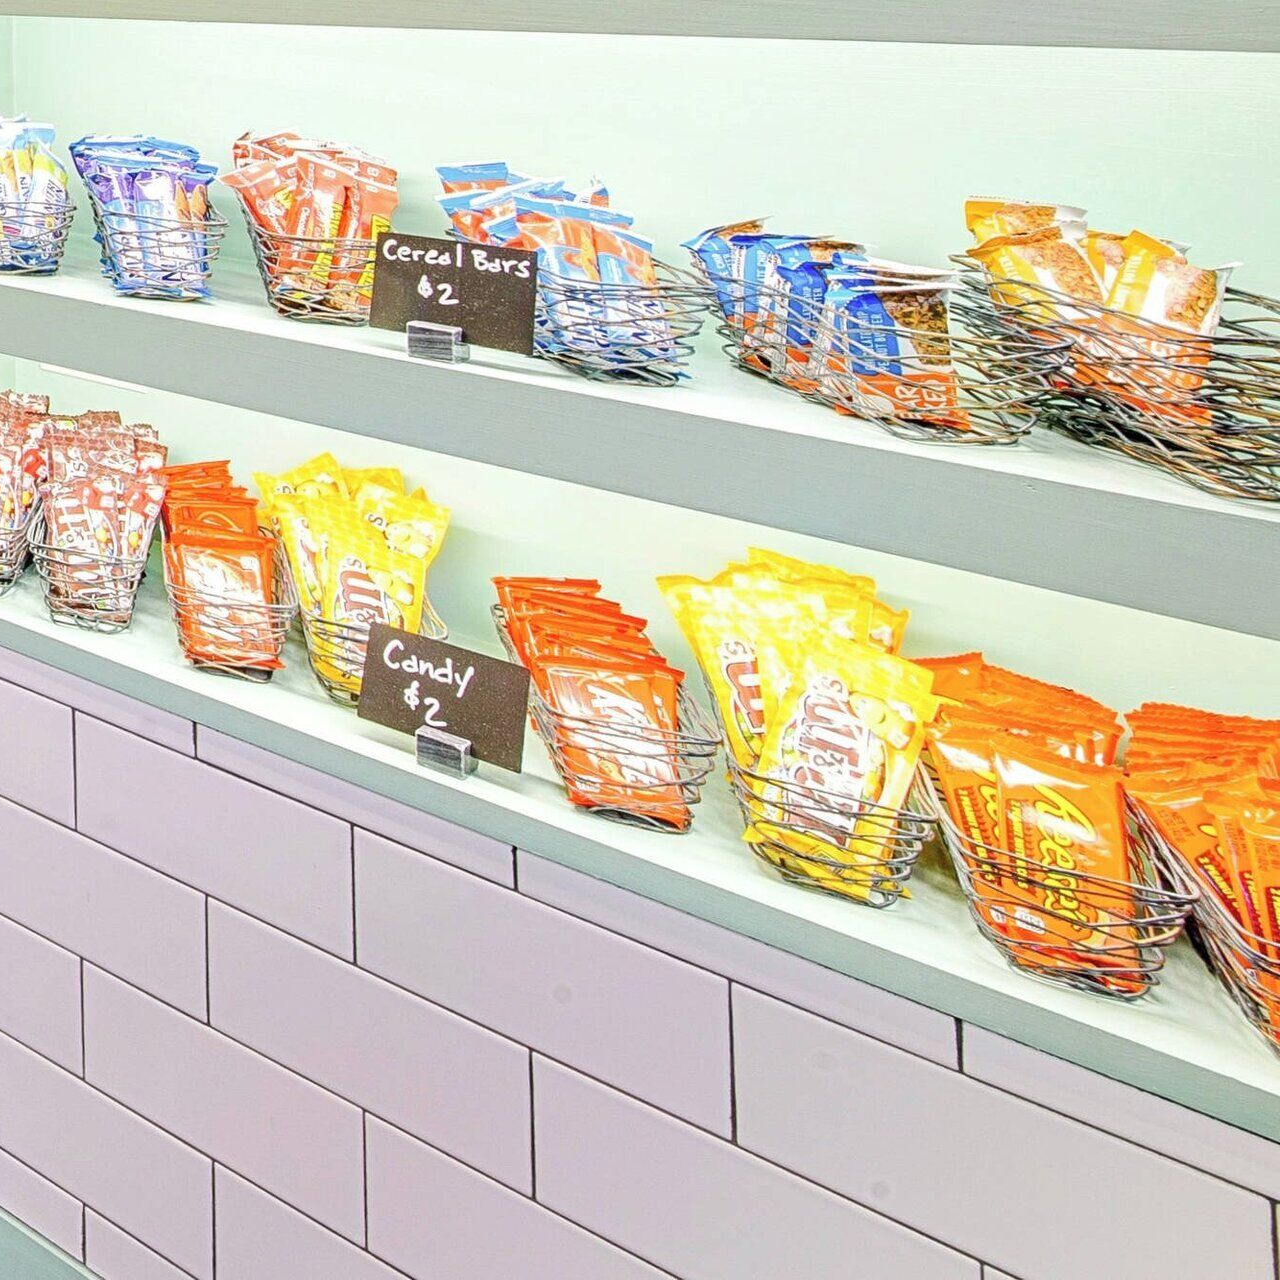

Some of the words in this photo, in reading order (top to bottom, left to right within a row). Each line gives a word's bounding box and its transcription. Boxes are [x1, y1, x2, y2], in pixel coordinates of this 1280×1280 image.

[381, 238, 463, 269] Cereal
[472, 248, 532, 279] Bars
[416, 273, 460, 307] $2
[382, 638, 475, 698] Candy
[402, 681, 447, 728] $2
